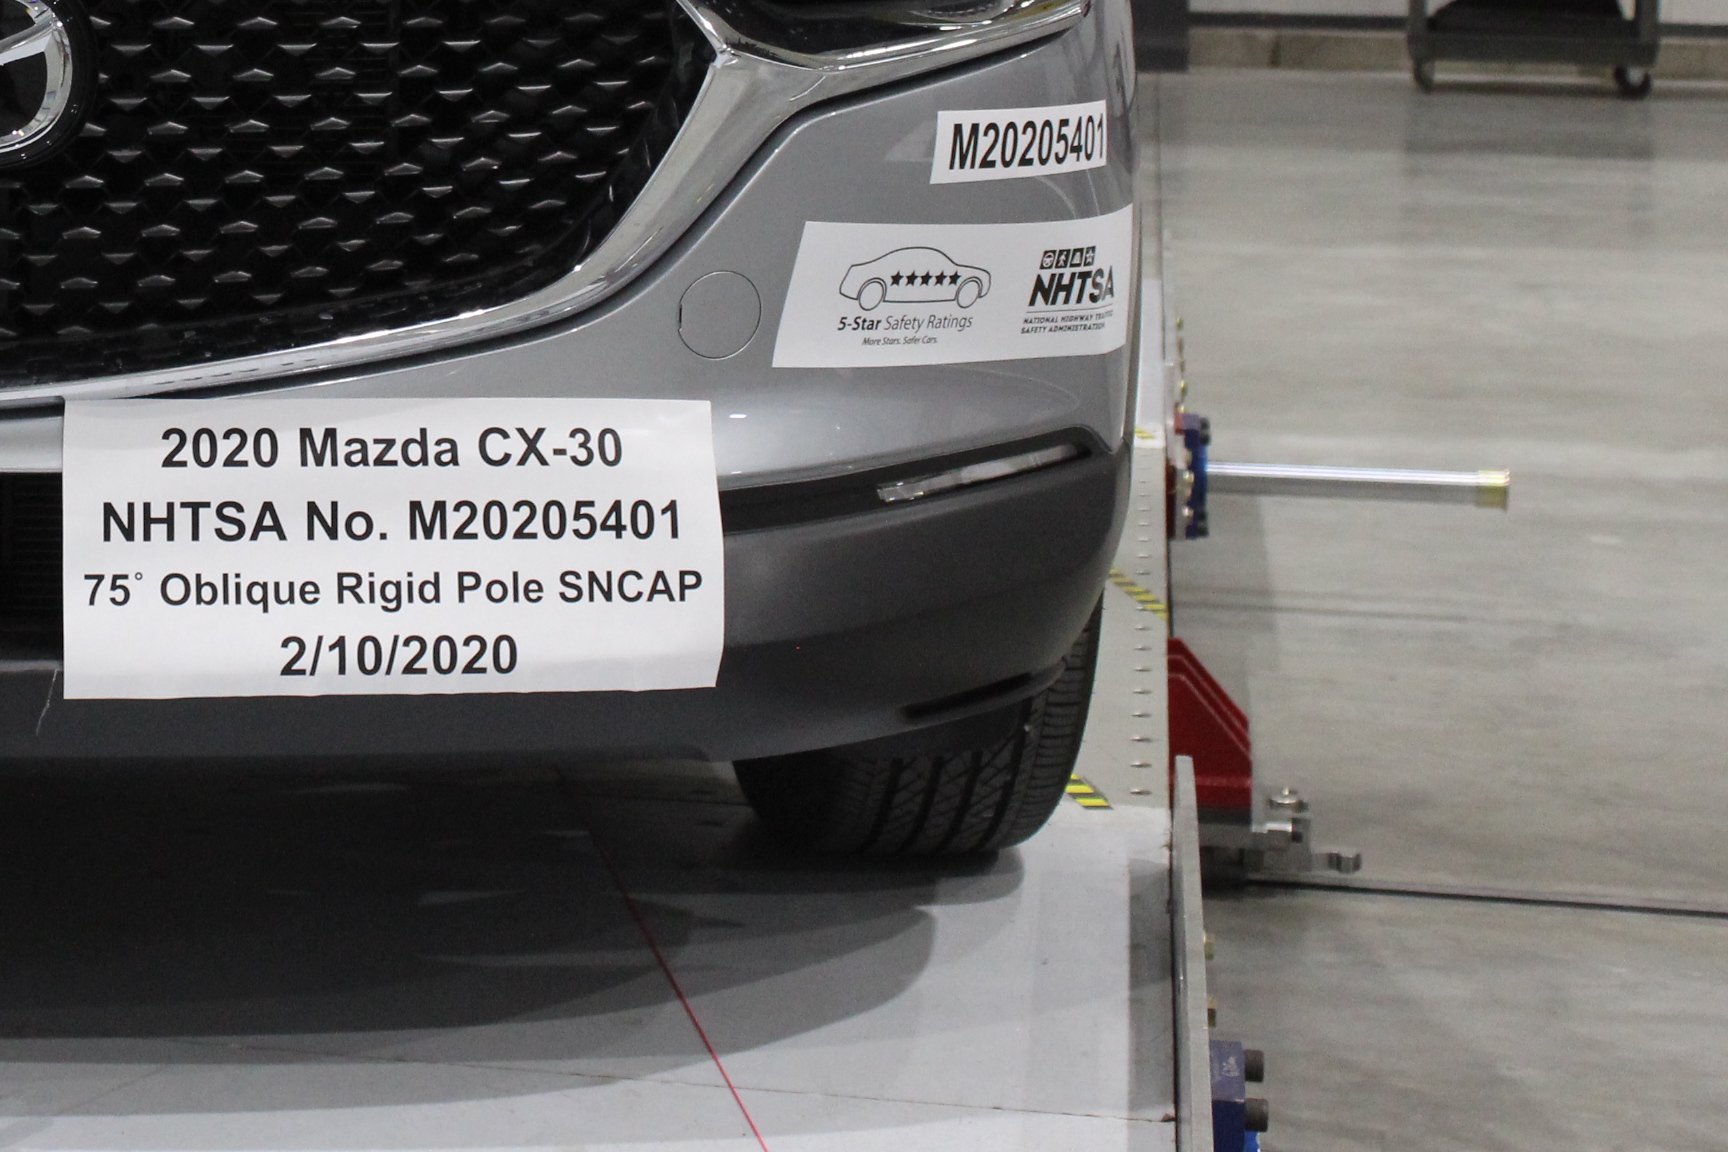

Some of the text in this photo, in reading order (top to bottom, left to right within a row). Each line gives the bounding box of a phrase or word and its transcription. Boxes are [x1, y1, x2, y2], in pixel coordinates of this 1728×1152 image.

[948, 112, 1105, 171] M20205401
[1028, 265, 1114, 307] NHTSA
[837, 313, 974, 333] 5-Star Safety Ratings
[861, 336, 882, 346] More
[902, 335, 922, 345] Safer
[1020, 326, 1047, 334] SAFETY
[1022, 316, 1059, 325] NATIONAL
[1060, 314, 1094, 323] HIGHWAY
[161, 426, 622, 468] 2020 Mazda CX-30
[103, 499, 680, 543] NHTSA No. M20205401
[160, 572, 320, 614] Oblique
[337, 571, 442, 613] Rigid
[457, 570, 544, 604] Pole
[558, 569, 703, 604] SNCAP
[279, 634, 518, 677] 2/10/2020
